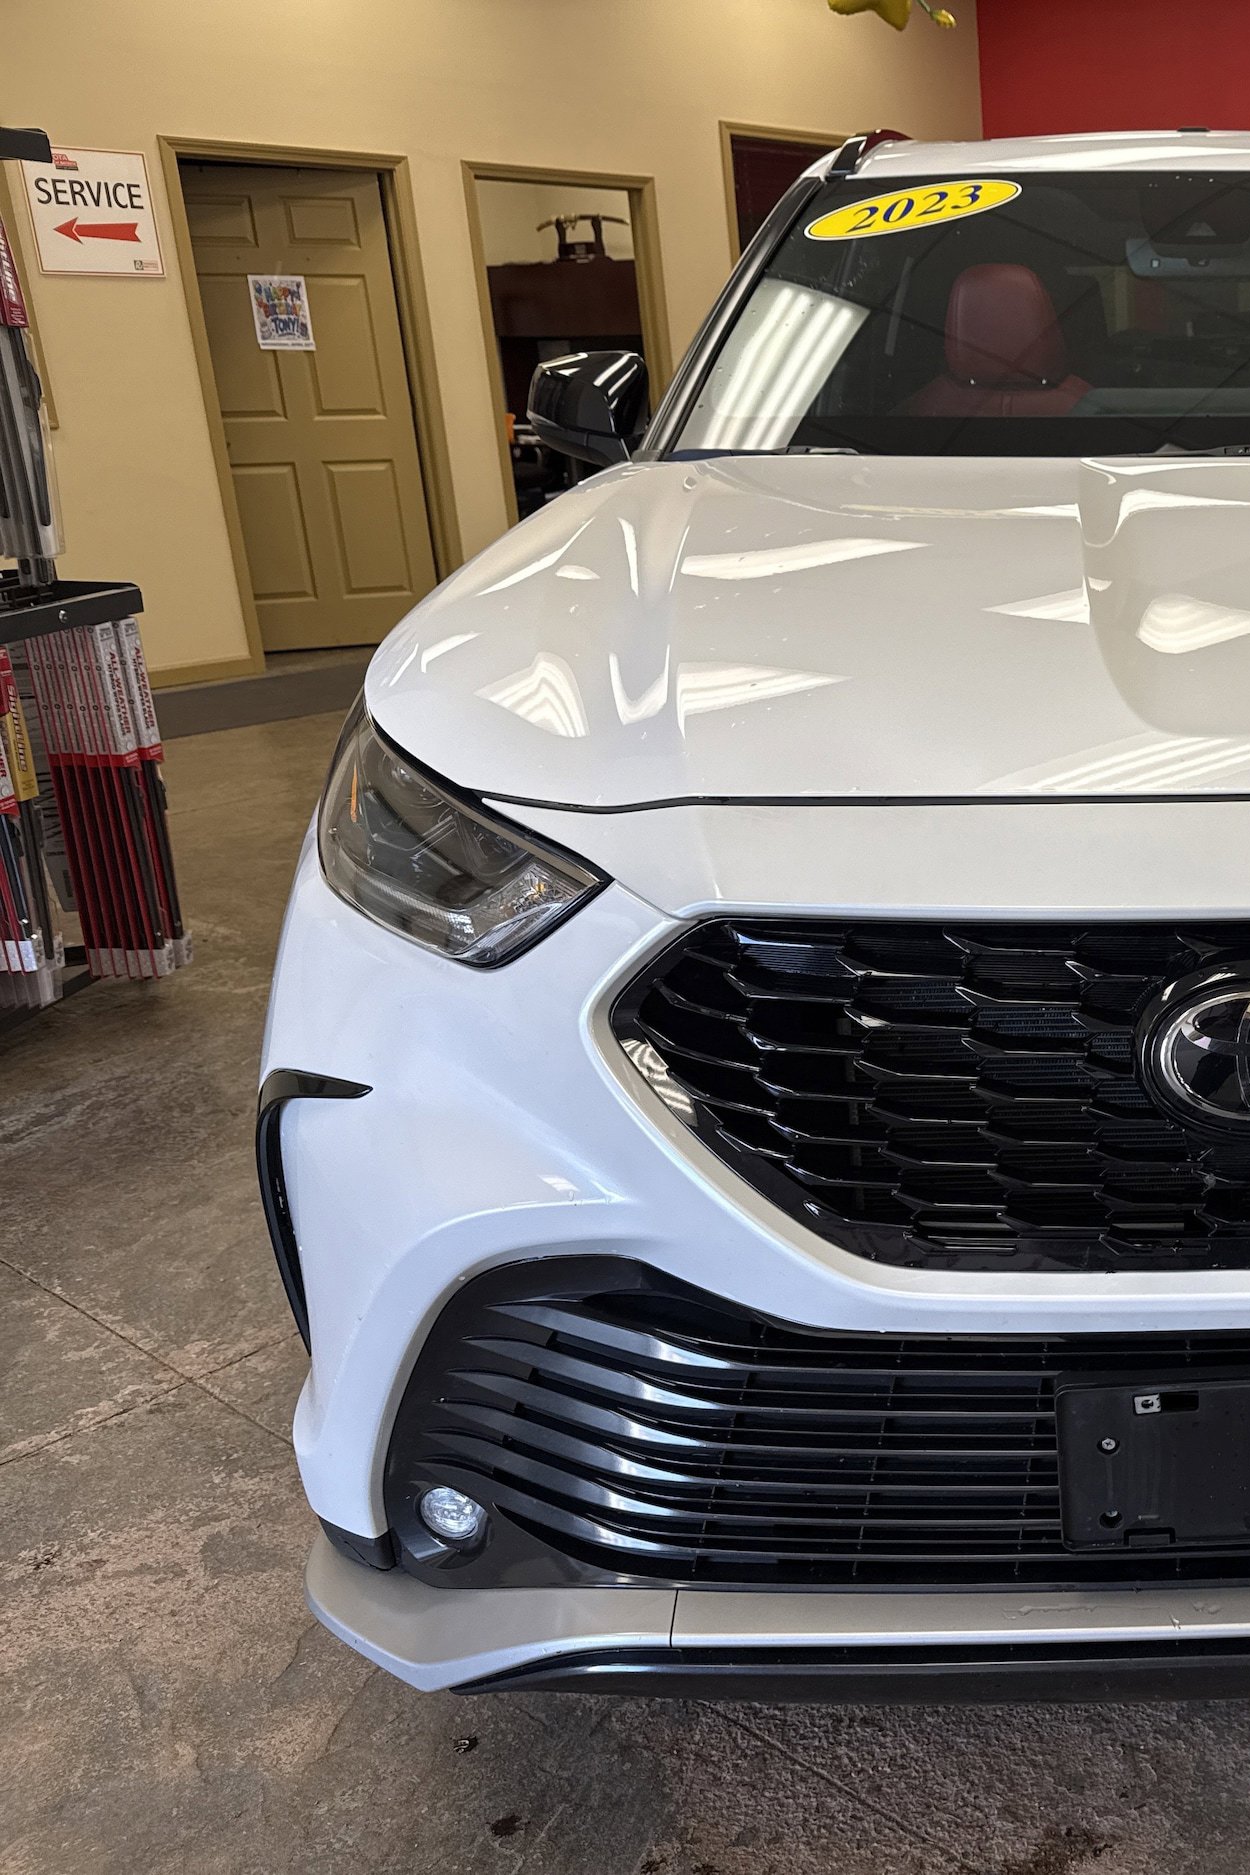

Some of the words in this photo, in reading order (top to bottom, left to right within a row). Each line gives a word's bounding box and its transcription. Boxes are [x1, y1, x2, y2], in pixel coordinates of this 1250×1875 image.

[34, 177, 144, 209] SERVICE
[846, 184, 983, 233] 2023
[109, 651, 131, 734] ALL-WEATHER
[134, 646, 156, 727] ALL-WEATHER
